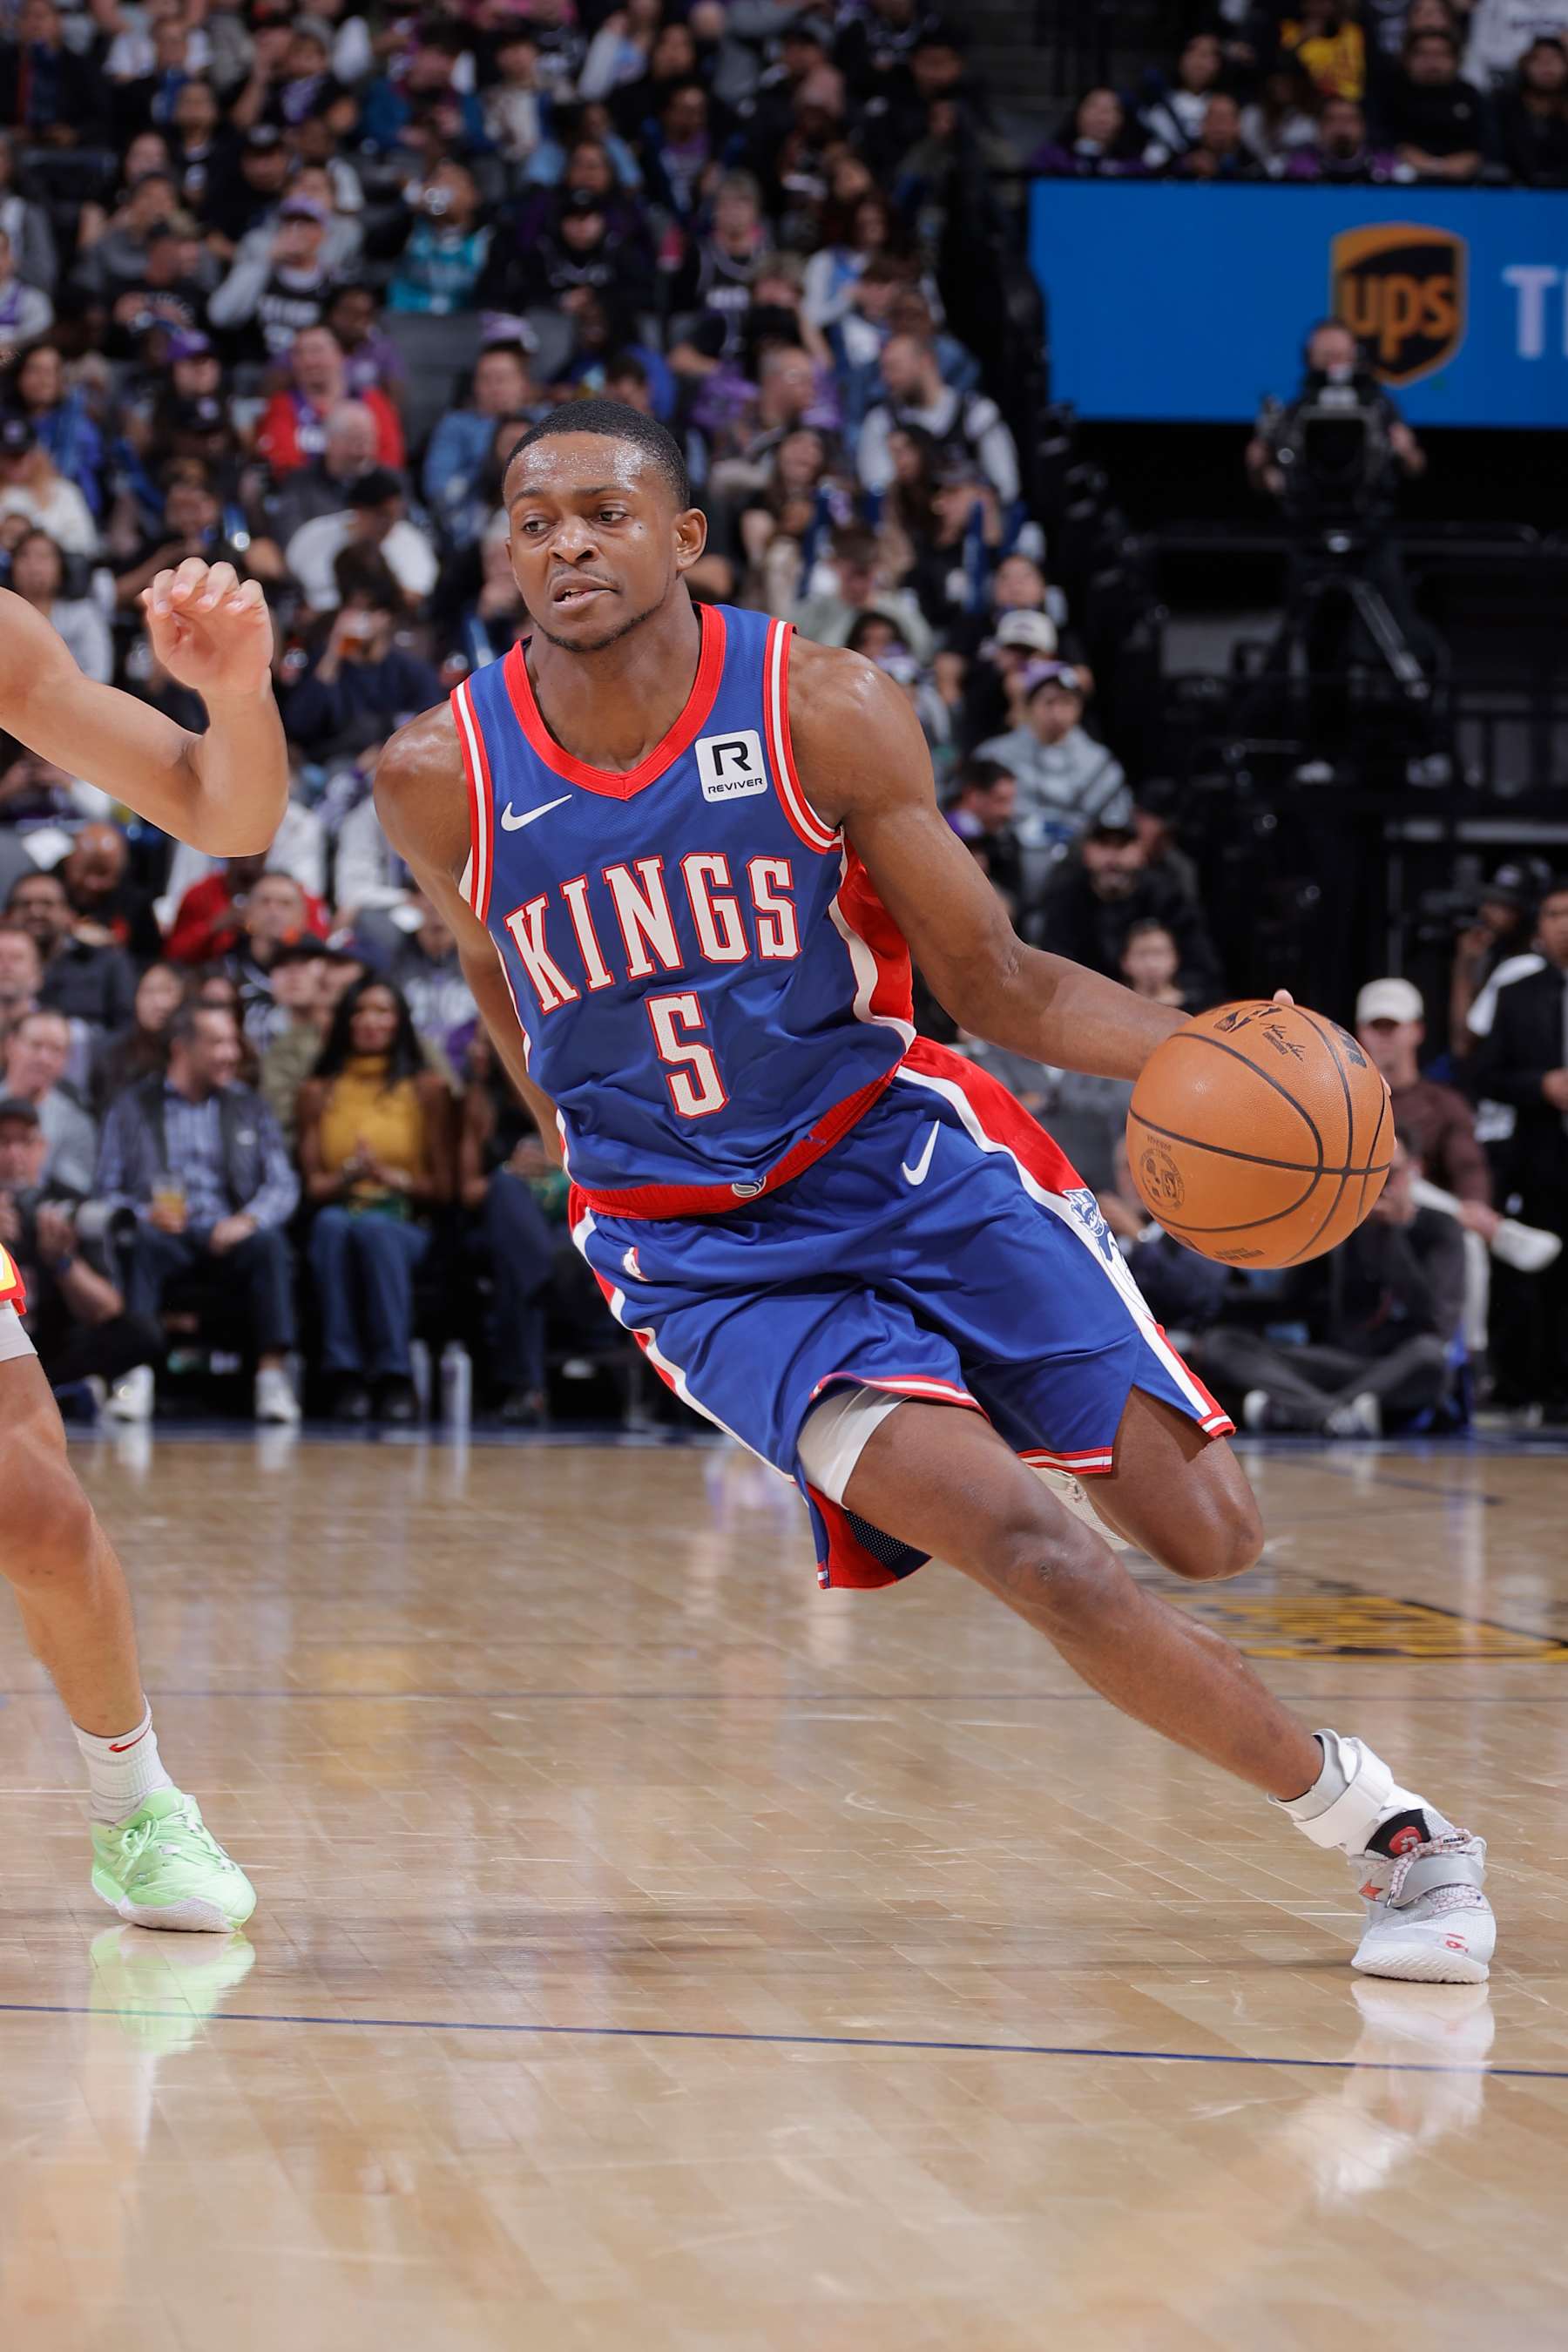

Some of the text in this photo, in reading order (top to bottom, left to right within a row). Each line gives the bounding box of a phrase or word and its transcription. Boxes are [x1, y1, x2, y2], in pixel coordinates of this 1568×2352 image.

[1342, 273, 1460, 362] ups
[1501, 264, 1568, 362] T
[707, 778, 763, 794] REVIVER
[712, 741, 752, 776] R
[504, 853, 803, 1015] KINGS
[645, 990, 730, 1119] 5
